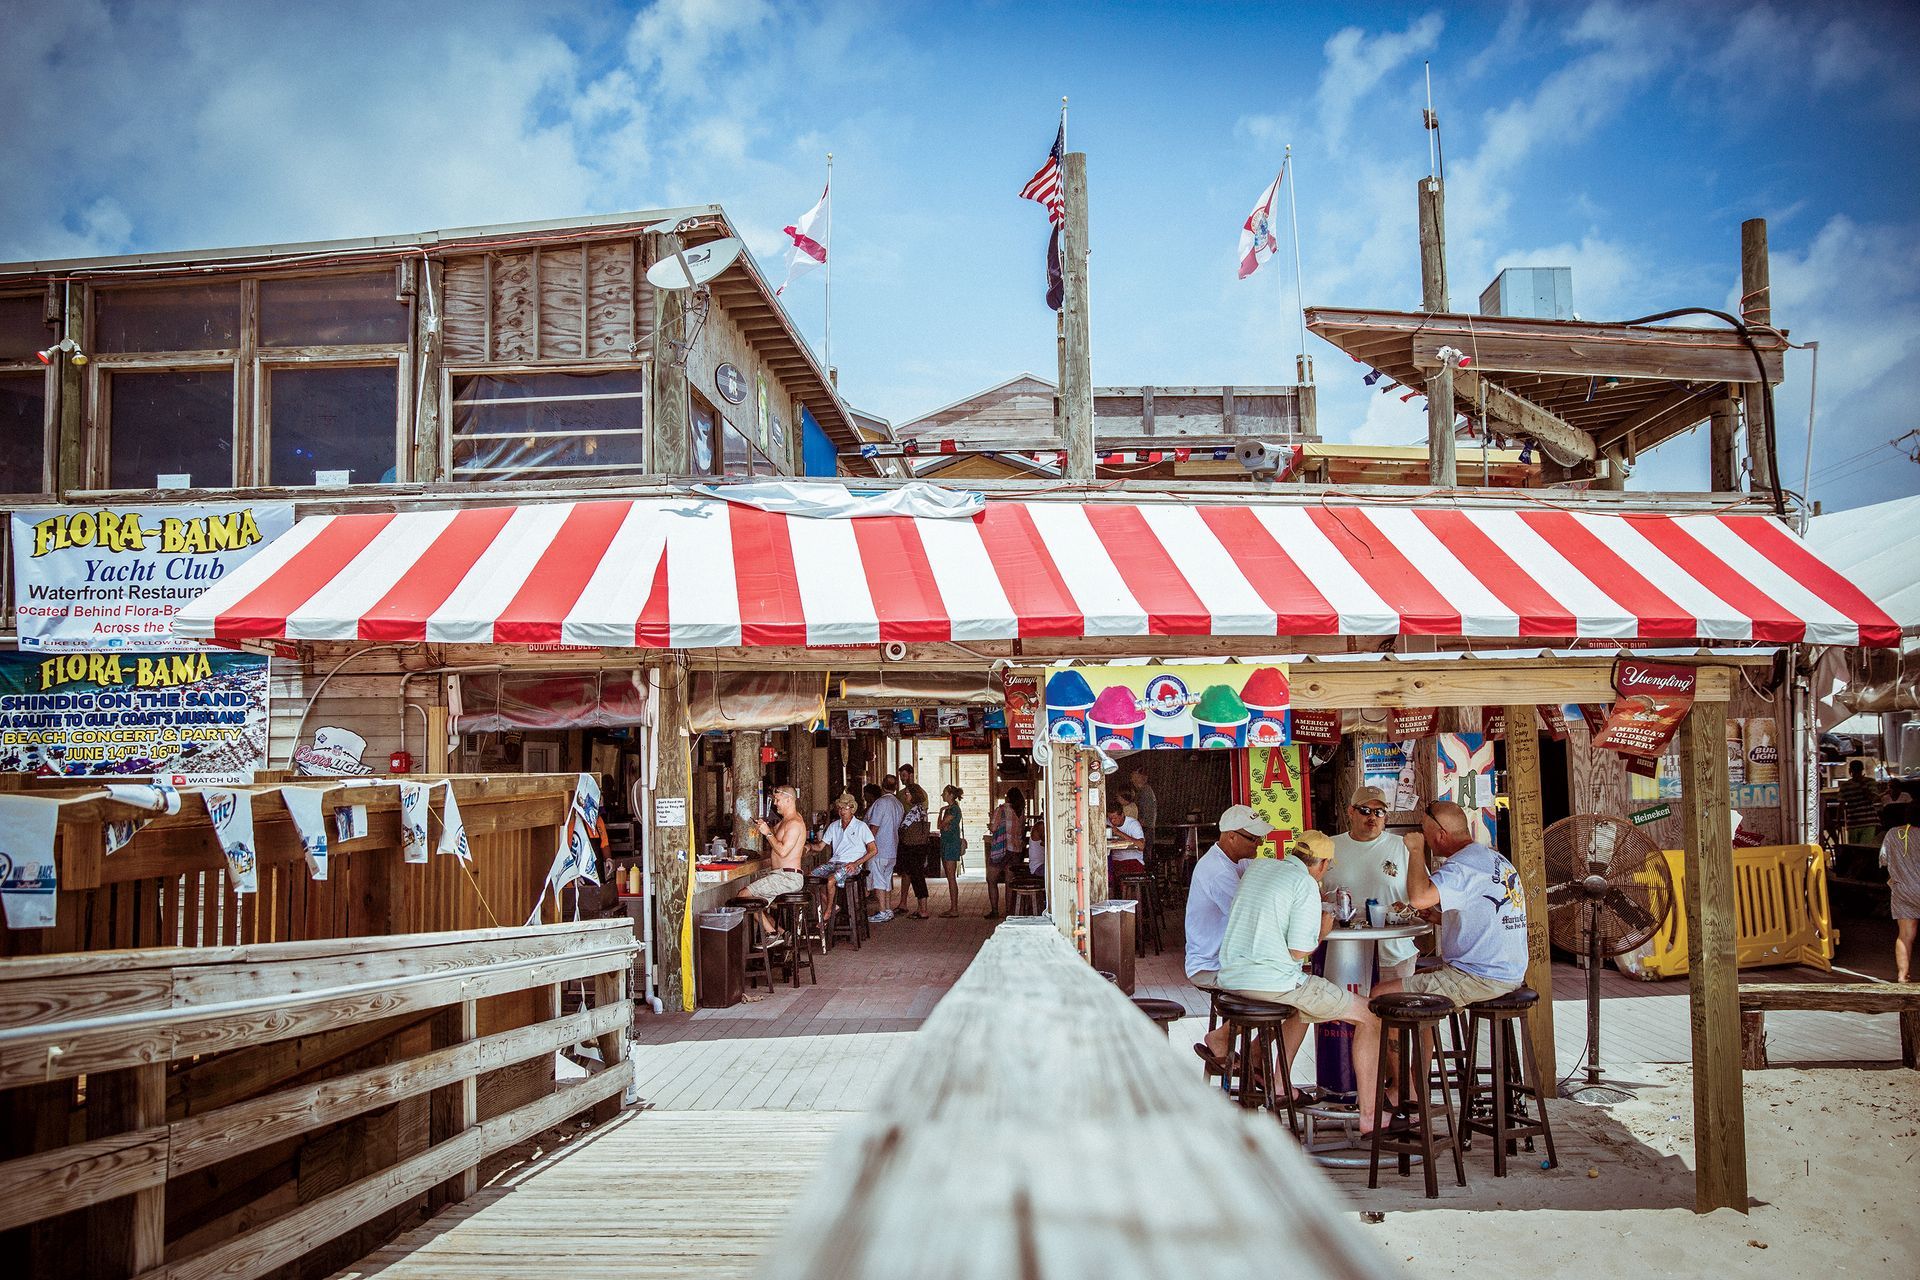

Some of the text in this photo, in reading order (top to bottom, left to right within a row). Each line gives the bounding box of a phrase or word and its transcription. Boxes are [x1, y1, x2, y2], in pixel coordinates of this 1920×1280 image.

[31, 508, 264, 558] FLORA-BAMA
[84, 557, 225, 582] Yacht Club
[29, 584, 124, 600] Waterfront
[16, 606, 69, 617] ocated
[74, 605, 121, 617] Behind
[93, 622, 141, 634] Across
[144, 621, 167, 633] the
[40, 654, 213, 691] FLORA-BAMA
[1622, 666, 1694, 691] Yuengling
[1, 692, 247, 711] SHINDIG ON THE SAND
[1, 710, 245, 728] A SALUTE TO GULF COAST'S MUSICIANS
[1295, 719, 1335, 727] AMERICA'S
[1393, 714, 1433, 723] AMERICA'S
[1399, 720, 1427, 728] OLDEST
[4, 728, 242, 744] BEACH CONCERT & PARTY
[1611, 726, 1665, 738] AMERICA'S
[1616, 732, 1655, 743] OLDEST
[1606, 736, 1657, 750] BREWERY.
[65, 746, 103, 761] JUNE
[108, 745, 138, 760] 14TH
[151, 744, 180, 759] 16TH
[294, 745, 375, 776] Coors LIGHT
[1751, 753, 1778, 761] LIGHT
[1634, 807, 1671, 824] Heineken
